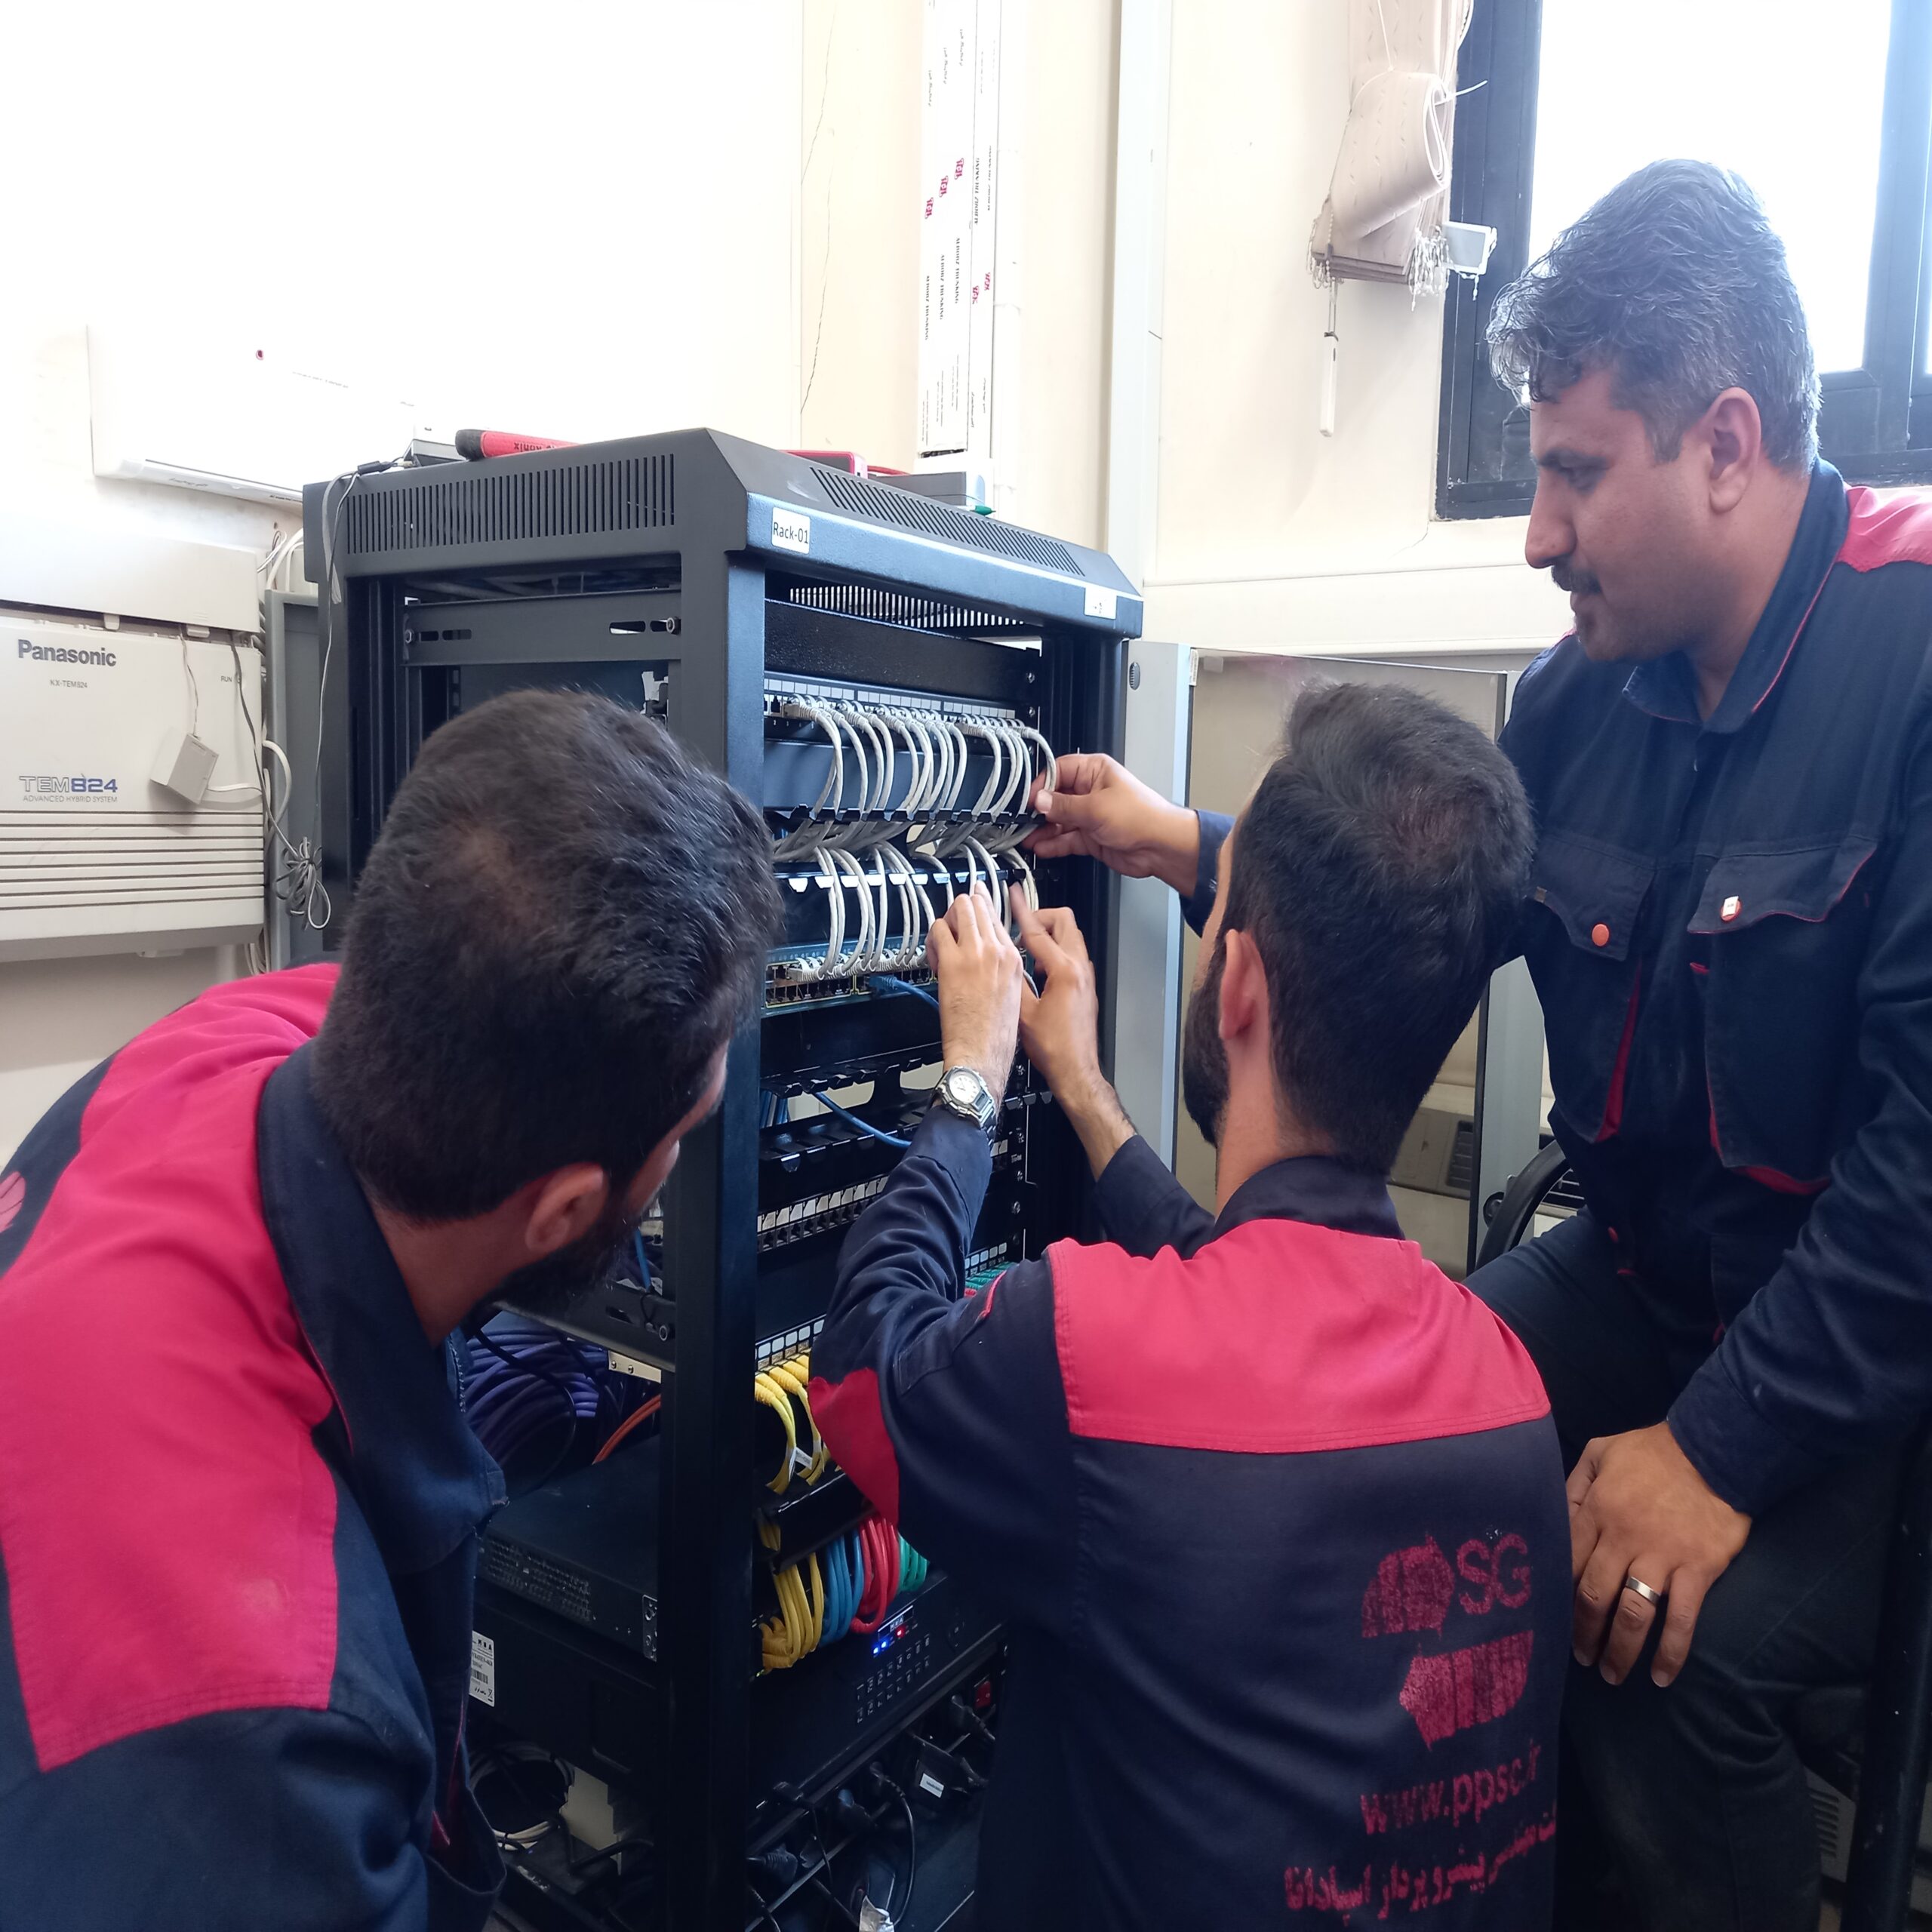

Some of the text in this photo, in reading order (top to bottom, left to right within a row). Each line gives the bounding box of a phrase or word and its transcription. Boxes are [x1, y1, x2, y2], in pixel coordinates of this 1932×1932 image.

[773, 521, 809, 544] Rack-01
[17, 638, 117, 666] Panasonic
[50, 679, 88, 689] KX-TEM824
[19, 775, 118, 793] TEM824
[23, 795, 118, 804] ADVANCED HYBRID SYSTEM
